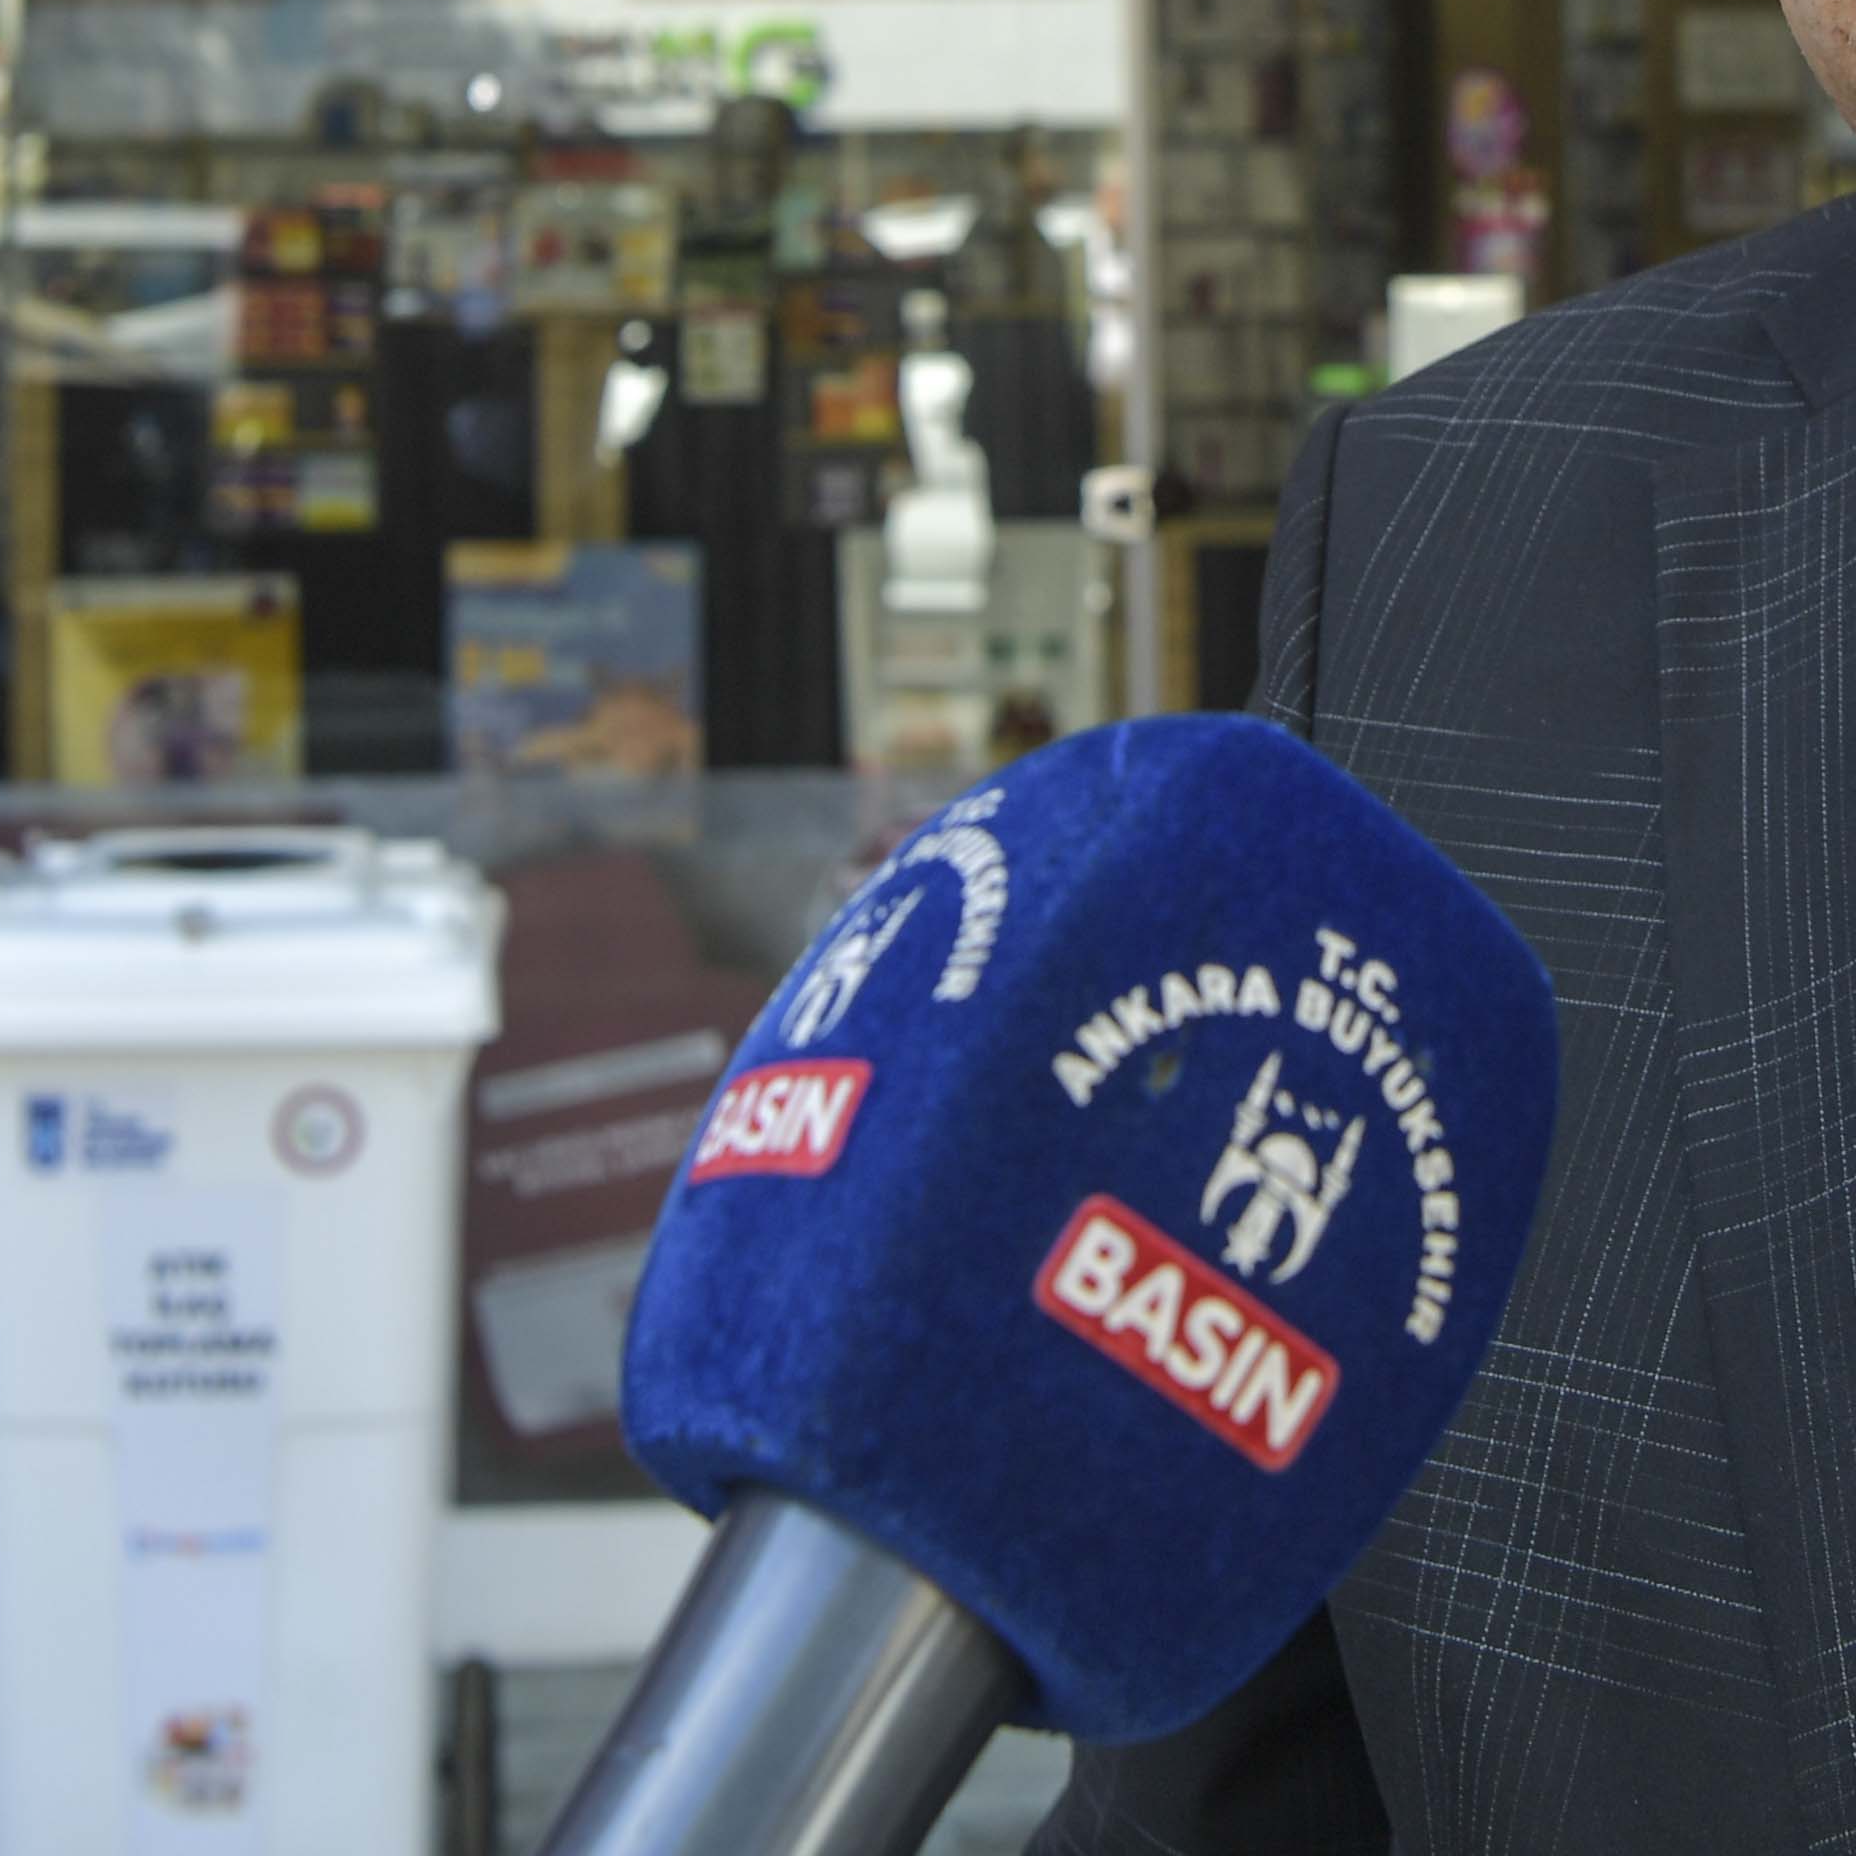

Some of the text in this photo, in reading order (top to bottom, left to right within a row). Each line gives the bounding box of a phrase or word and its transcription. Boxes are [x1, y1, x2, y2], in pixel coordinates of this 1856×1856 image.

[1052, 963, 1281, 1109] ANKARA
[1314, 926, 1402, 1024] T.C.
[1052, 1215, 1325, 1451] BASIN
